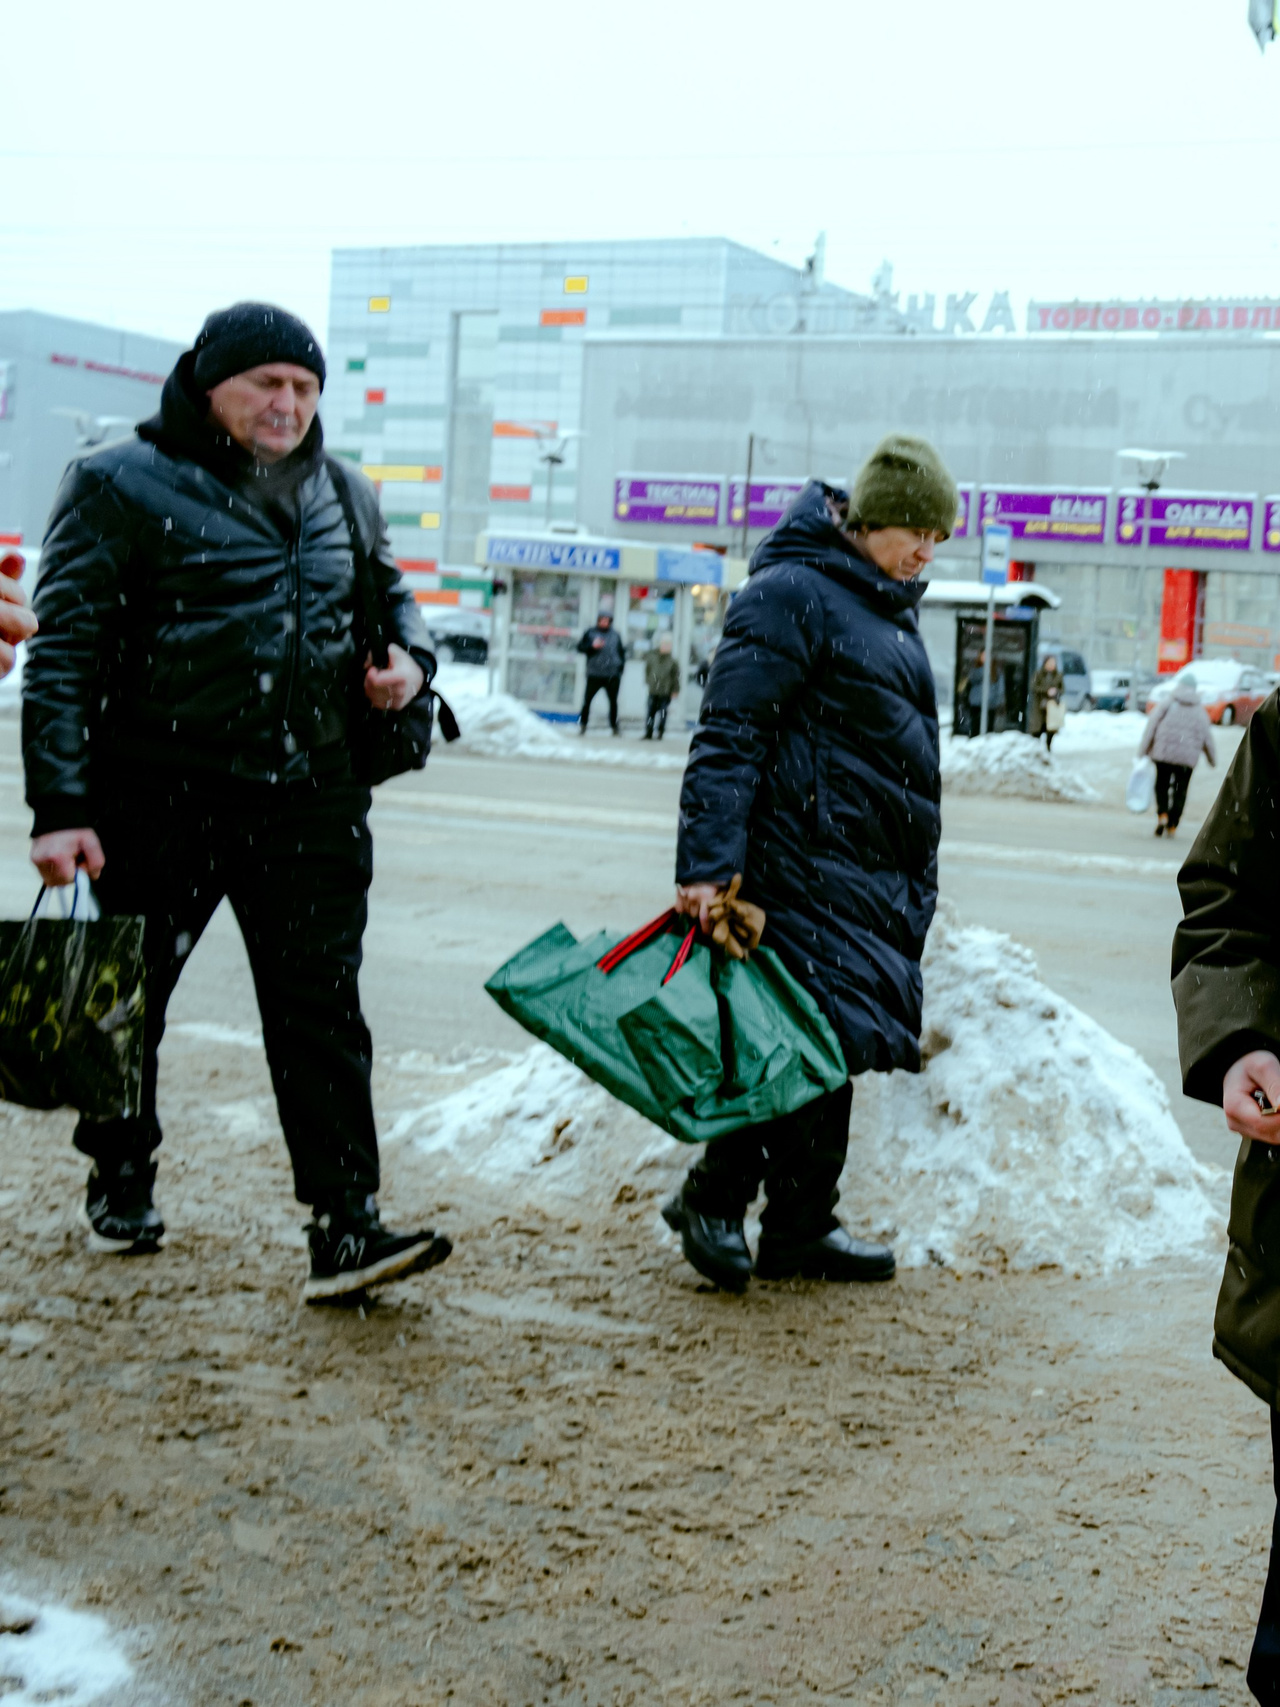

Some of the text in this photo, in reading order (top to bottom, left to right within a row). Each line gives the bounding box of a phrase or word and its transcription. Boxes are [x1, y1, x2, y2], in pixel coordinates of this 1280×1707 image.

[645, 483, 718, 501] ТЕКСТИЛЬ
[1122, 497, 1137, 521] 2
[1165, 502, 1249, 526] ОДЕЖДА
